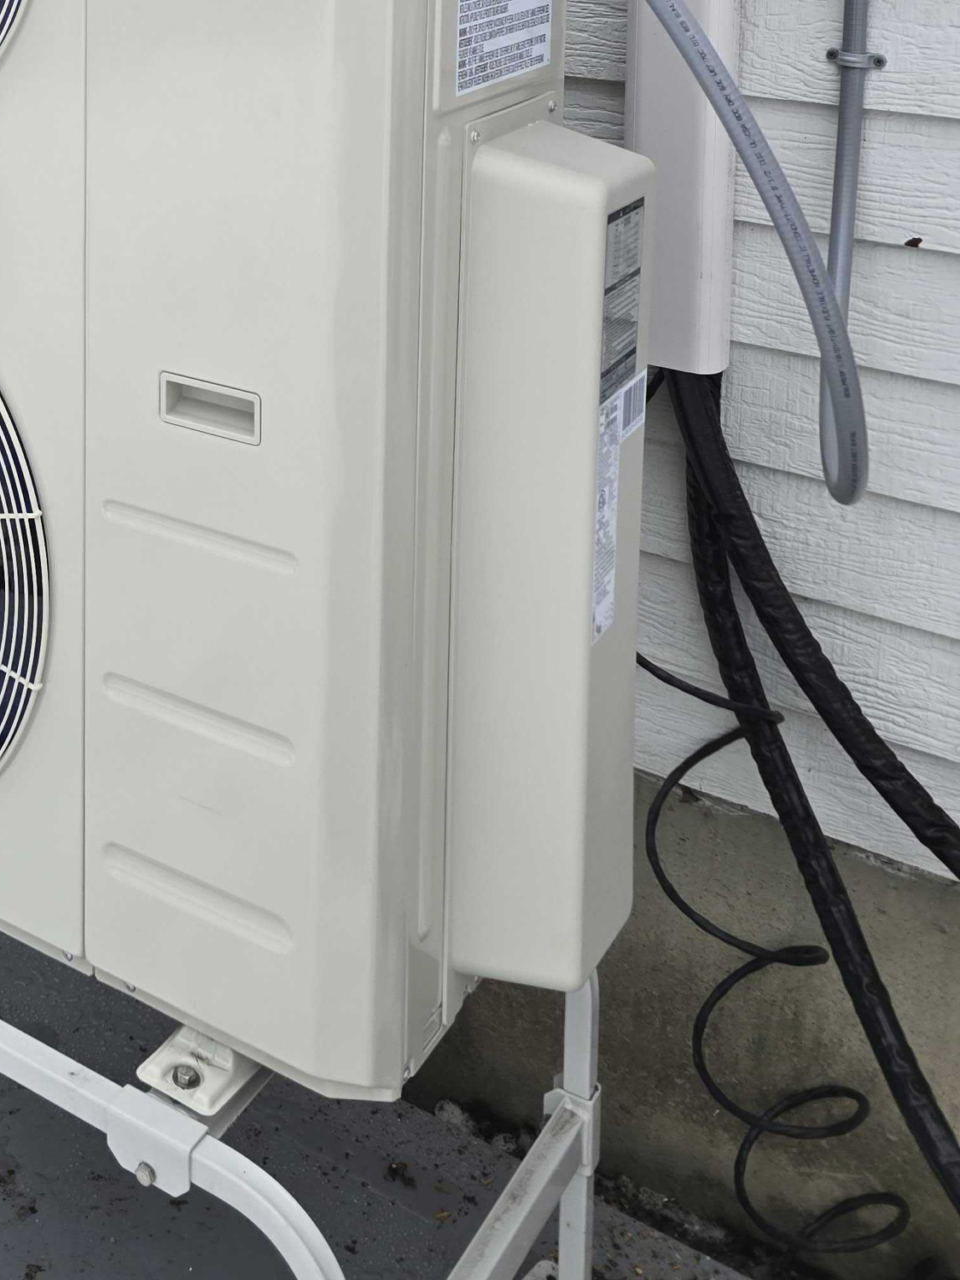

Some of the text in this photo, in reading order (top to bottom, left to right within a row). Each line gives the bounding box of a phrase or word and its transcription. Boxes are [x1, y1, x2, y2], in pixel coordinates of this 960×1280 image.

[680, 20, 690, 32] RES
[689, 35, 699, 46] OIL
[706, 64, 718, 76] WET
[724, 94, 735, 105] DRY
